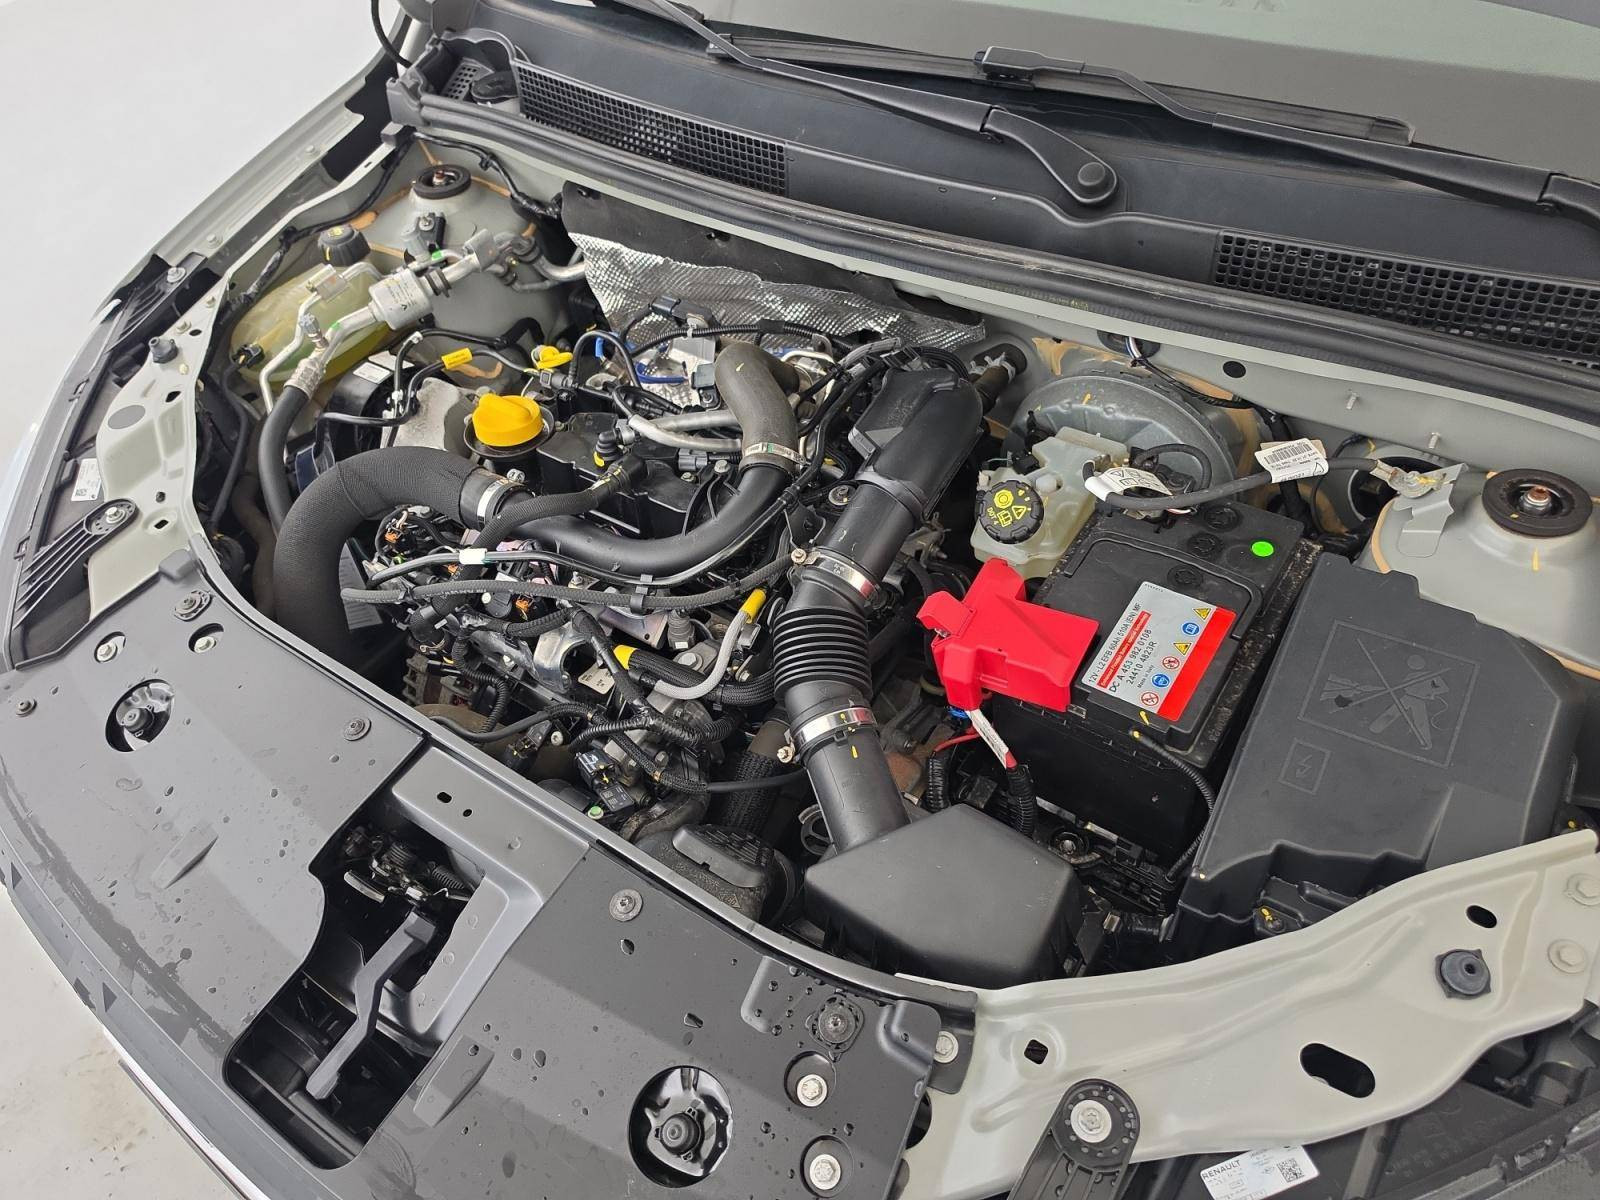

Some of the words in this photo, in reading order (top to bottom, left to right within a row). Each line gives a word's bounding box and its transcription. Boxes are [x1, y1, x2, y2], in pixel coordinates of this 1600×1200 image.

[1087, 672, 1099, 683] 12V
[1096, 661, 1105, 669] L2
[1101, 649, 1112, 662] EFB
[1116, 622, 1130, 636] 510A
[1109, 681, 1120, 692] DC
[1120, 659, 1133, 673] 453
[1129, 646, 1141, 659] 982
[1125, 662, 1144, 685] 24410
[1138, 640, 1157, 663] 4823R
[1201, 1159, 1241, 1180] RENAULT
